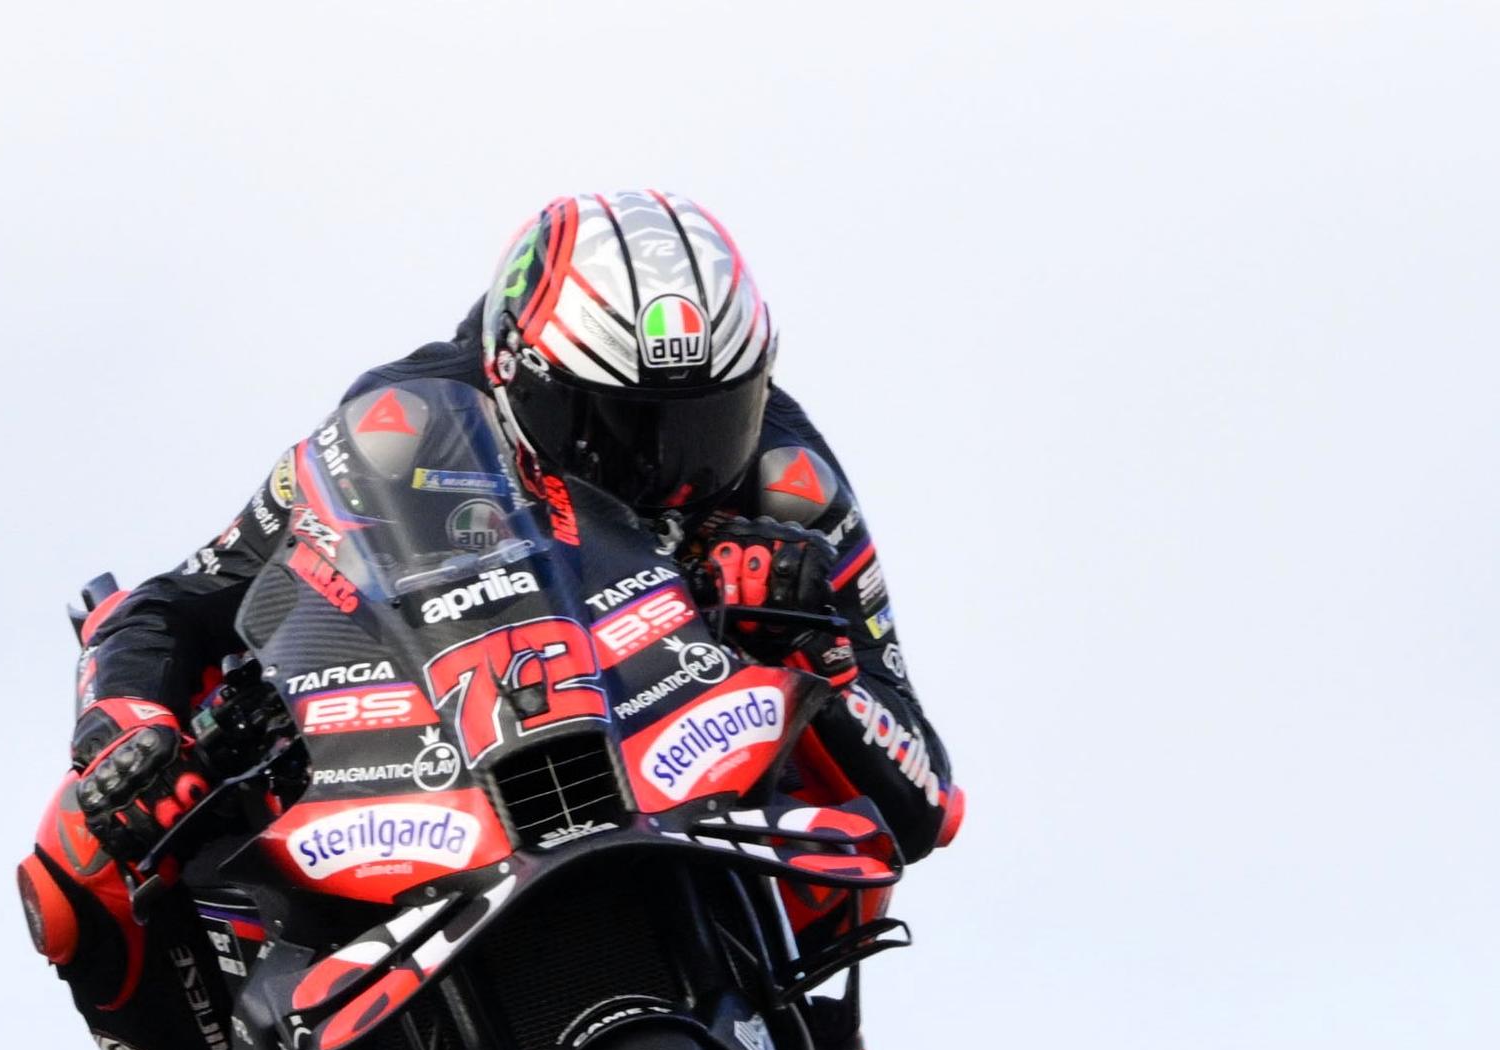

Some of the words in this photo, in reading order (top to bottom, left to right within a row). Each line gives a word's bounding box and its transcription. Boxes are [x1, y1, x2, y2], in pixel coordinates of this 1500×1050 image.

[640, 240, 675, 257] 72
[653, 338, 700, 362] agv
[421, 568, 540, 624] aprilia
[585, 566, 680, 611] TARGA
[596, 592, 687, 650] BS
[286, 661, 396, 695] TARGA
[423, 616, 611, 770] 72
[613, 670, 692, 720] PRAGMATIC
[688, 649, 722, 677] PLAY
[304, 690, 417, 727] BS
[653, 691, 777, 788] sterilgarda
[313, 763, 414, 785] PRAGMATIC
[418, 759, 455, 776] PLAY
[299, 810, 466, 867] sterilgarda
